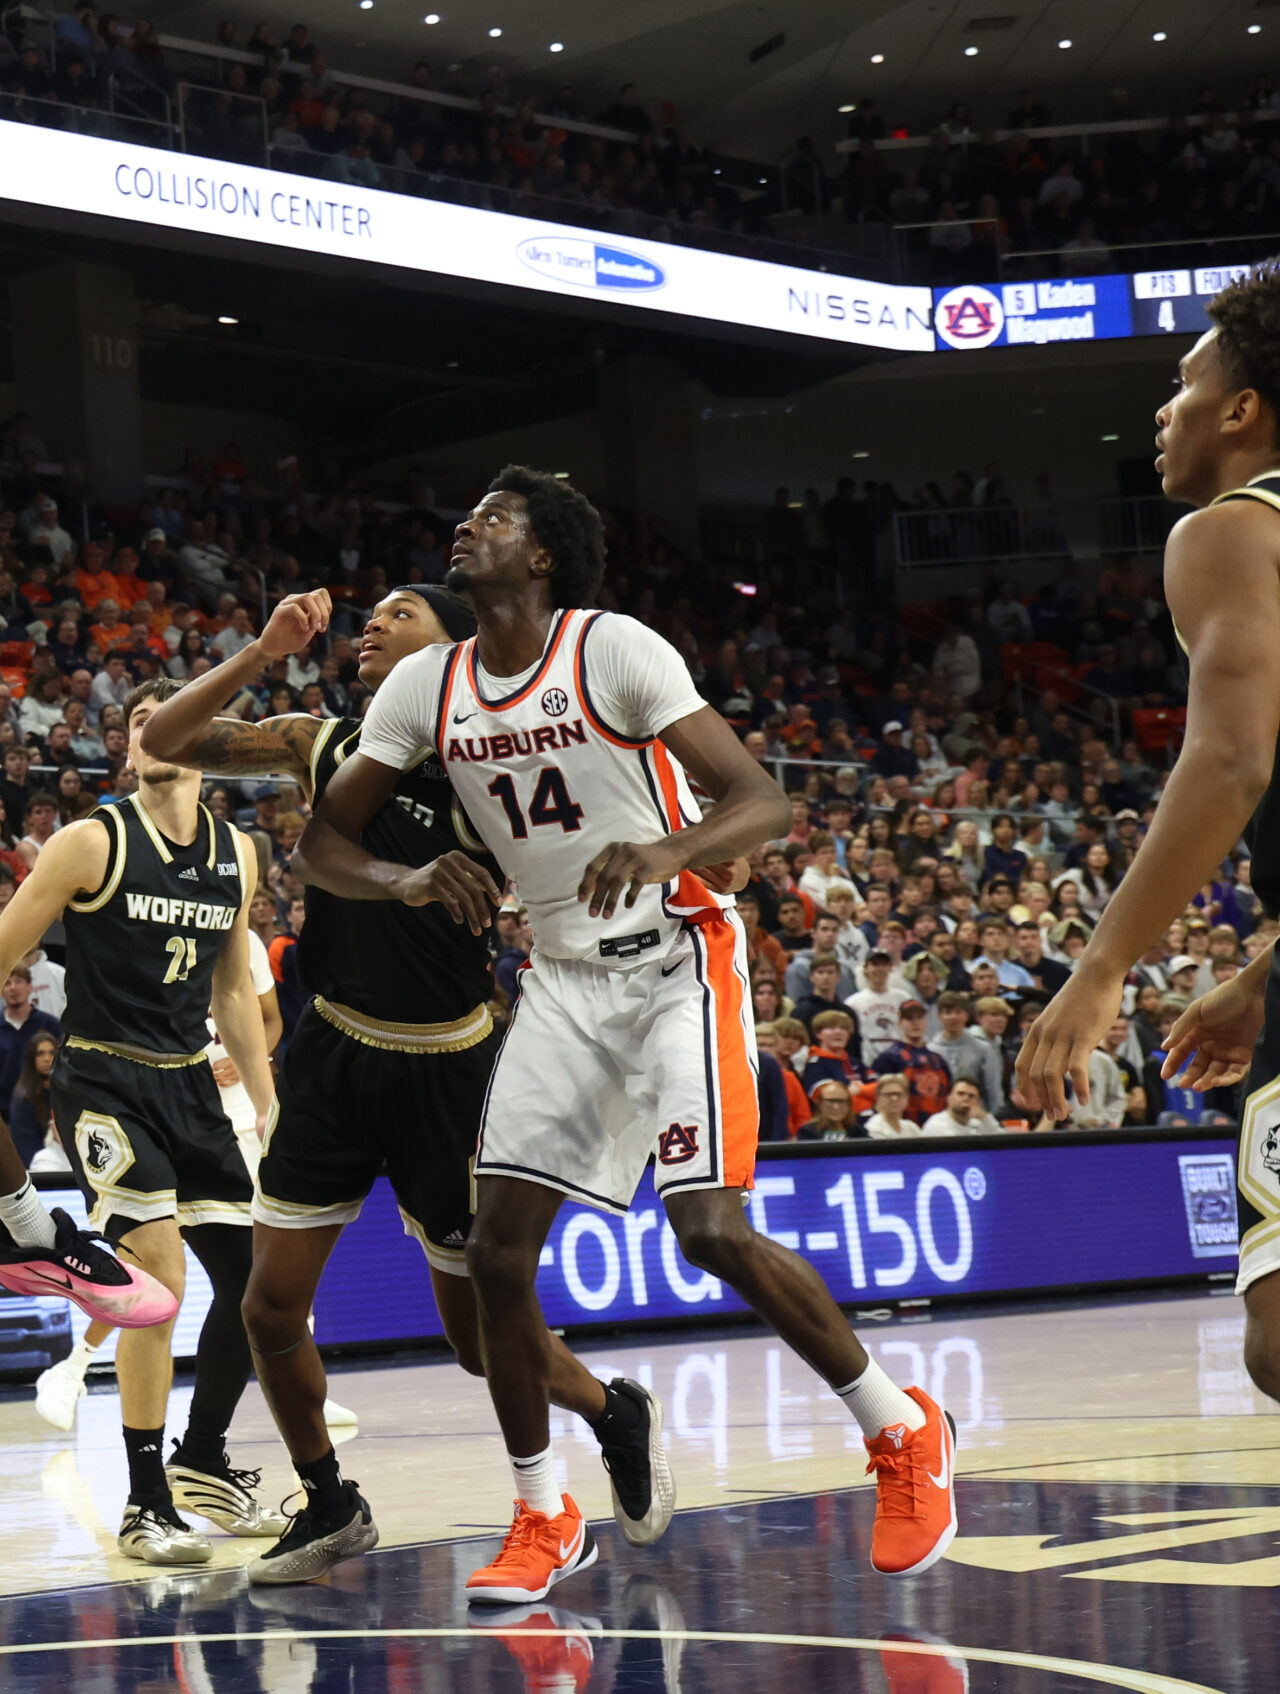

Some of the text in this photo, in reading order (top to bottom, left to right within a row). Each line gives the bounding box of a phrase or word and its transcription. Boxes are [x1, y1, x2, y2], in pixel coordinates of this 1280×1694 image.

[114, 164, 373, 239] COLLISION CENTER
[1150, 273, 1177, 295] PTS
[789, 287, 933, 332] NISSAN
[1158, 300, 1175, 332] 4
[91, 334, 132, 368] 110
[542, 689, 567, 715] SEC
[447, 718, 588, 763] AUBURN
[487, 766, 585, 840] 14
[178, 872, 200, 882] adidas
[125, 892, 238, 931] WOFFORD
[162, 936, 197, 985] 21
[538, 1208, 723, 1311] ord
